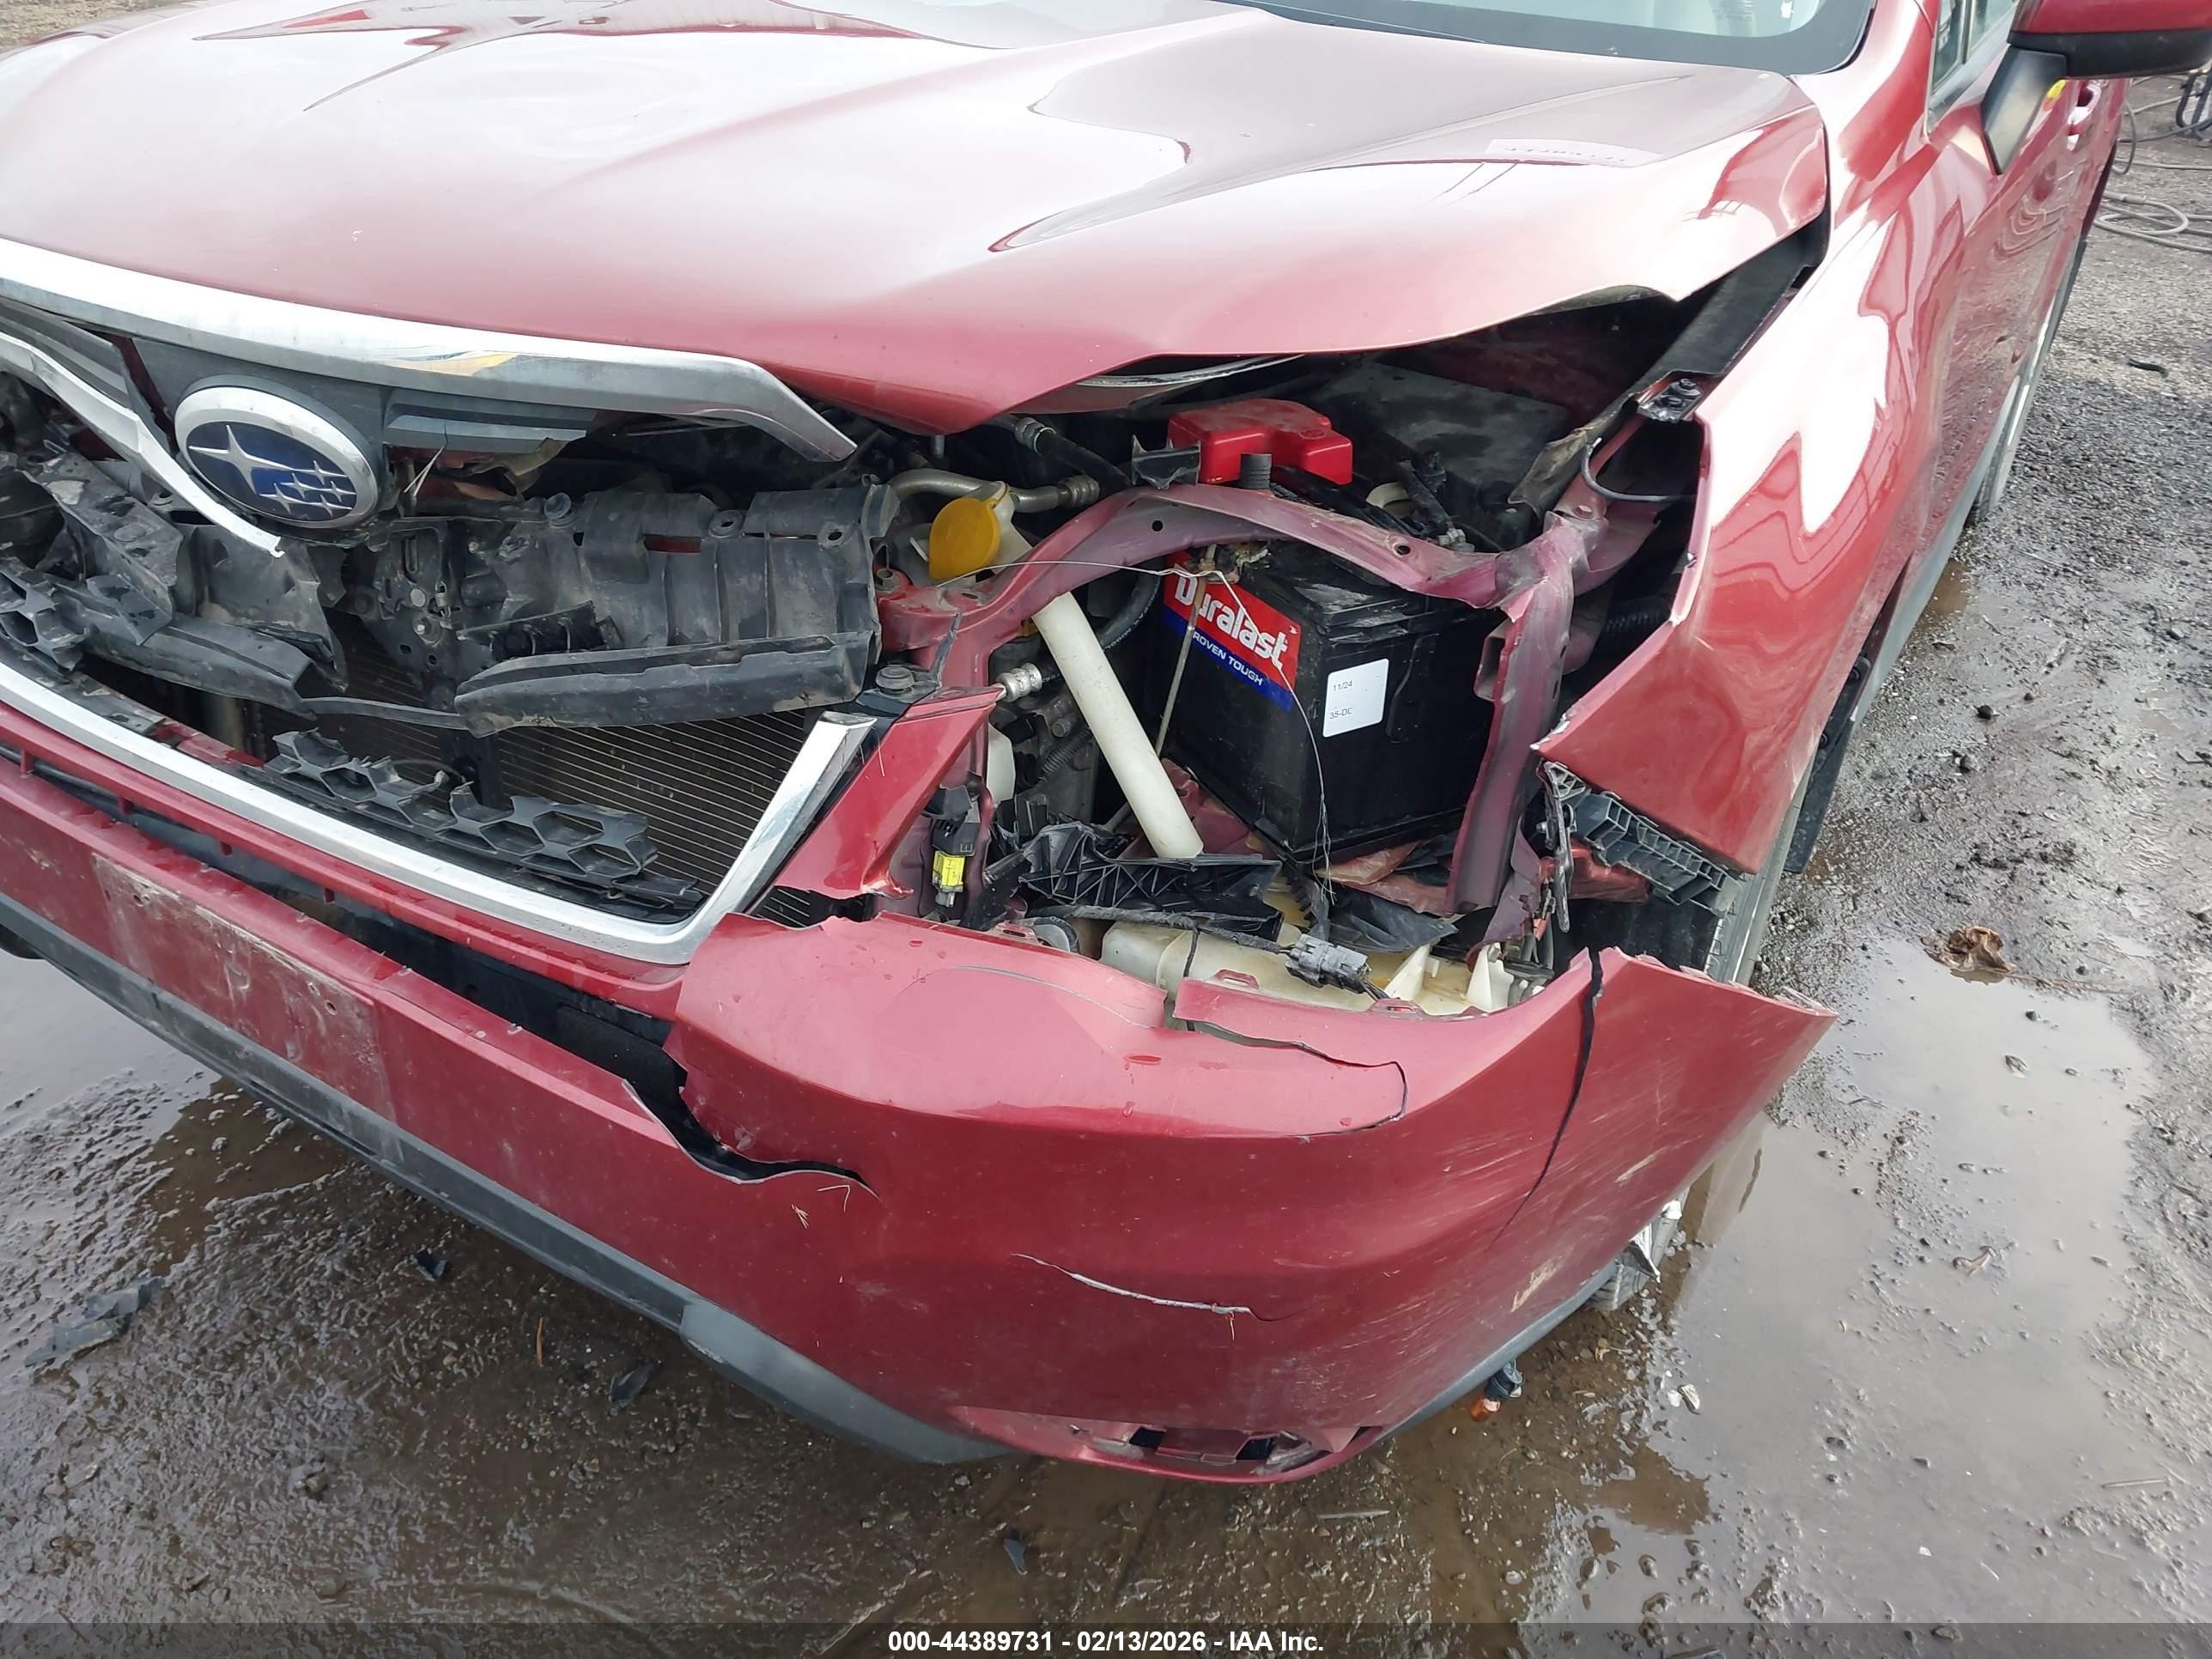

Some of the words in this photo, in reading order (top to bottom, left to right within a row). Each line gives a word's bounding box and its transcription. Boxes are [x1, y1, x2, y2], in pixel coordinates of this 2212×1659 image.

[1193, 631, 1227, 660] ROVEN
[1229, 655, 1264, 686] TOUGH
[1333, 680, 1353, 692] 11/24
